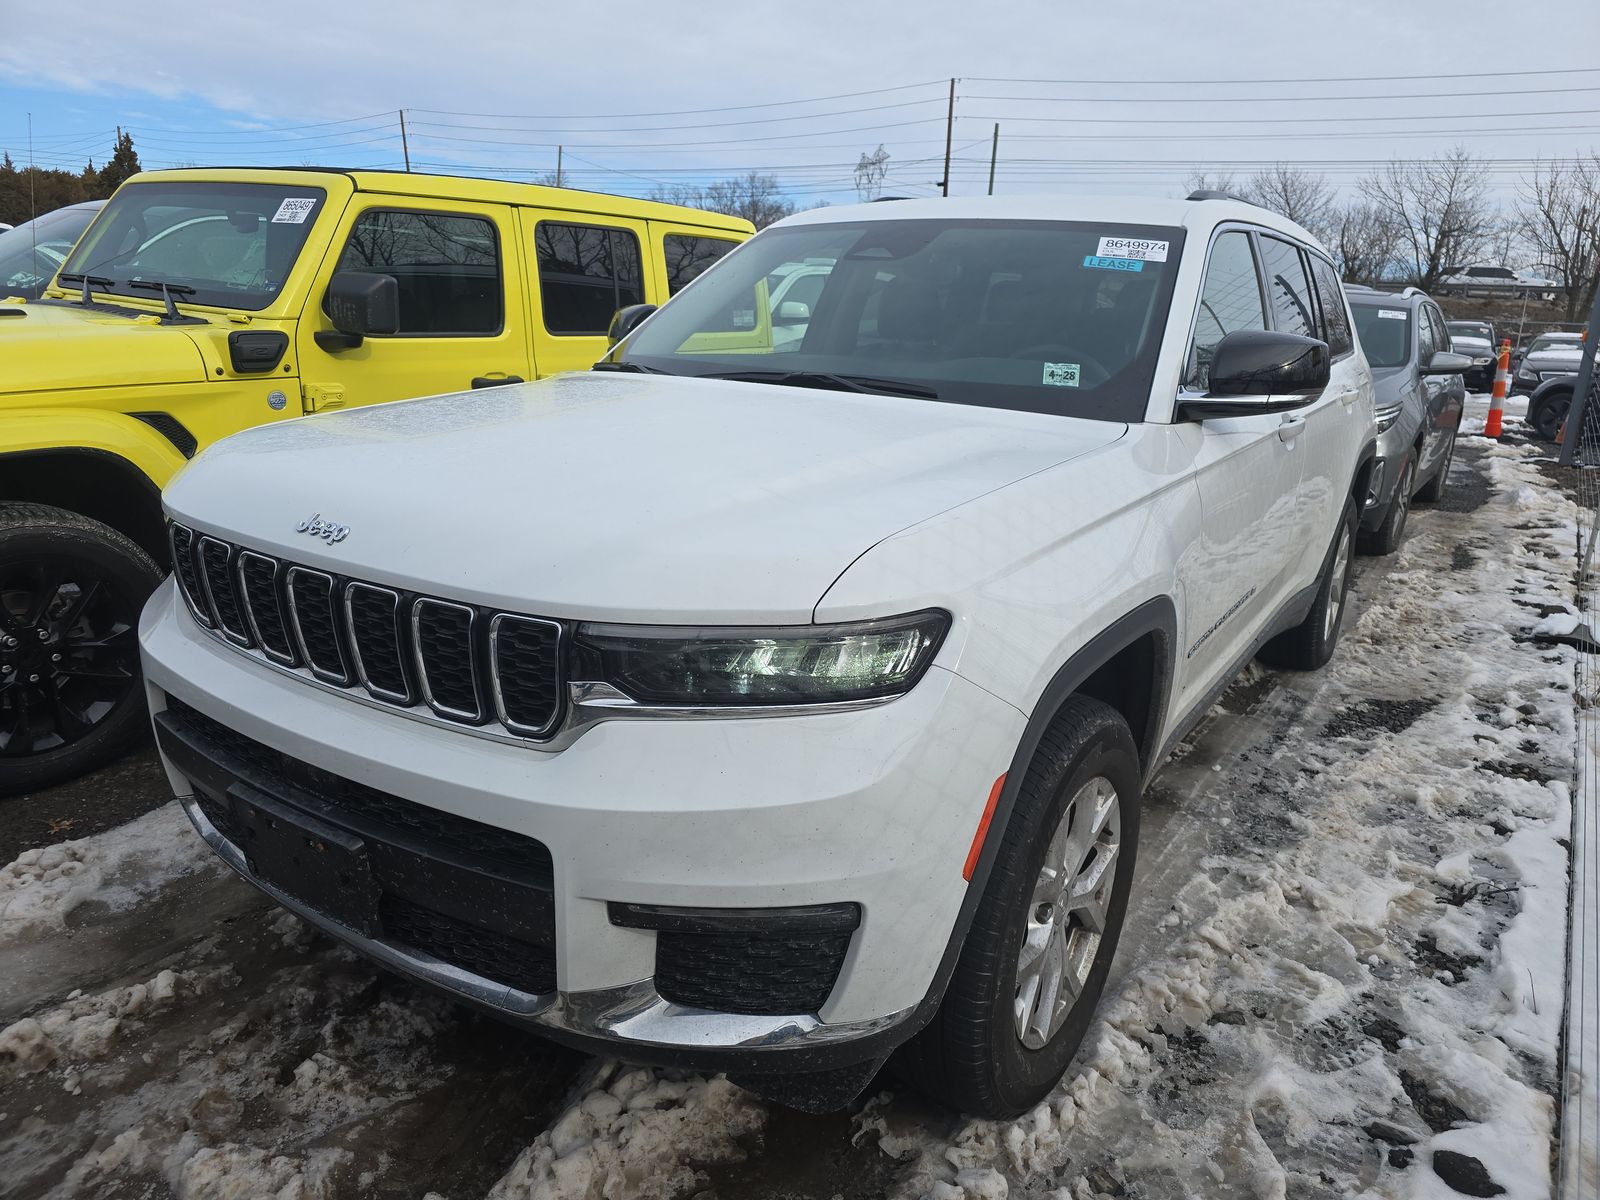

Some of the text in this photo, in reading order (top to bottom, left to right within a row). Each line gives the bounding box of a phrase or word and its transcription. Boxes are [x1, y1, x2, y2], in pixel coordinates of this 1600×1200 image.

[283, 200, 314, 211] 8650497
[1105, 239, 1166, 252] 8649974
[1089, 257, 1136, 270] LEASE
[1062, 370, 1076, 381] 28
[296, 512, 350, 546] Jeep
